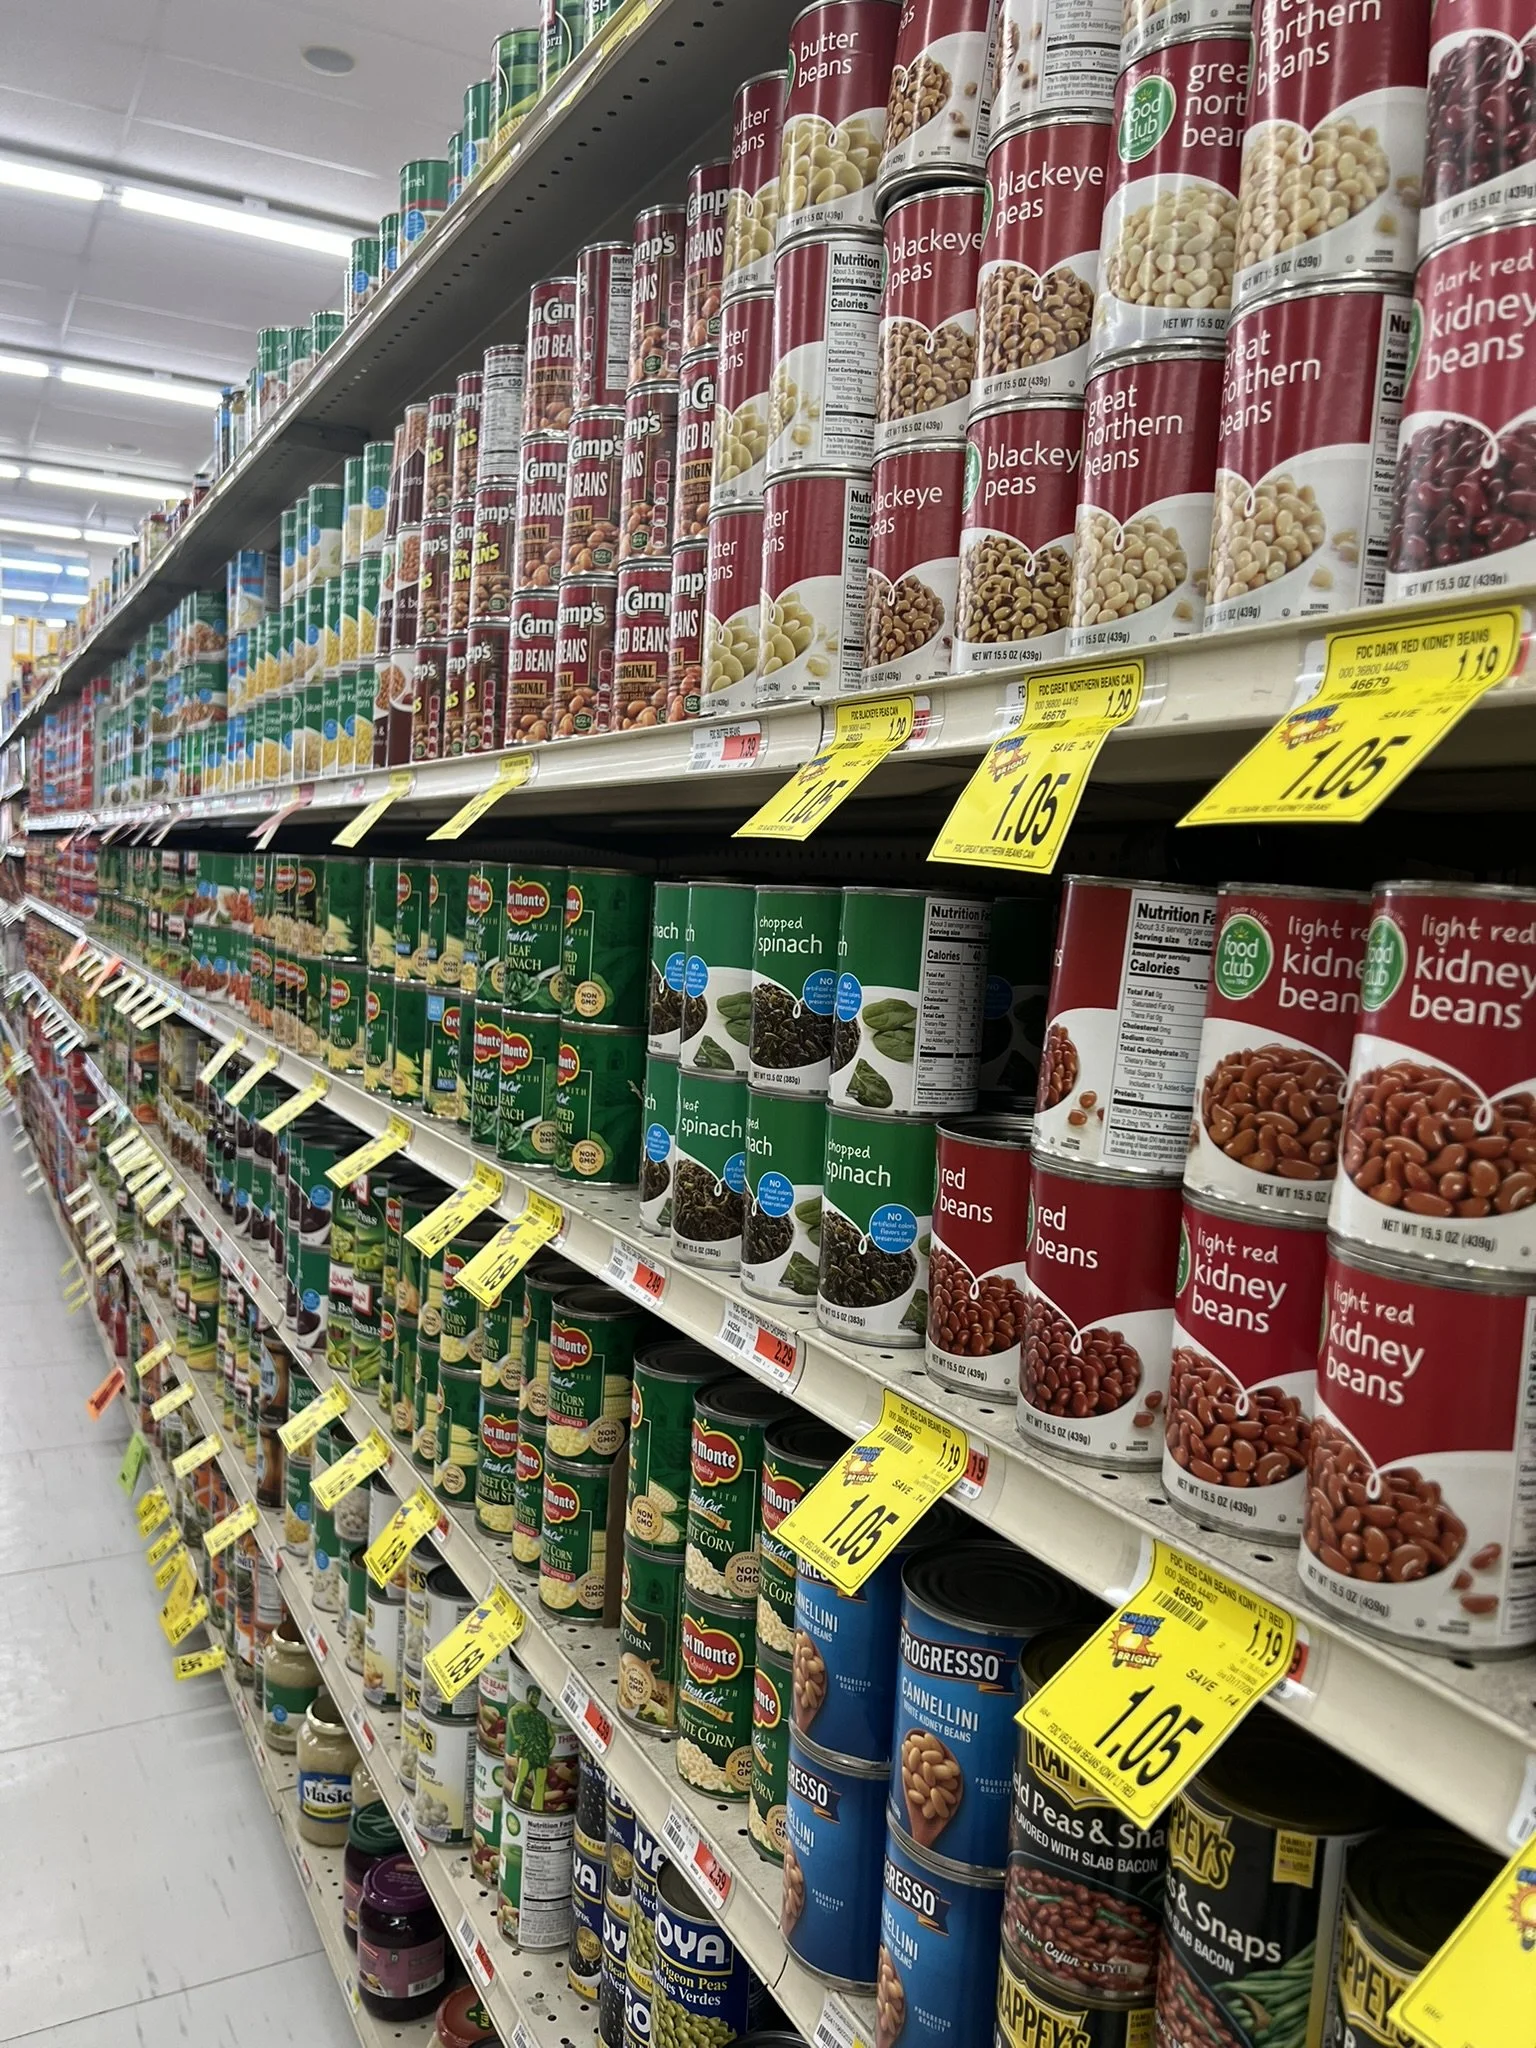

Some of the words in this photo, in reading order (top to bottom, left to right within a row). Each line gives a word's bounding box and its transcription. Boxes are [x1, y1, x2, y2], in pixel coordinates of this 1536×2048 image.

[800, 31, 858, 62] butter
[799, 57, 852, 88] beans
[1257, 38, 1329, 96] beans
[997, 161, 1103, 202] blackeye
[996, 198, 1043, 237] peas
[892, 228, 982, 264] blackeye
[834, 253, 880, 269] Nutrition
[1433, 268, 1481, 297] dark
[1490, 249, 1533, 275] red
[891, 260, 932, 297] peas
[831, 298, 869, 310] Calories
[1429, 289, 1536, 340] kidney
[1163, 318, 1178, 328] NET
[1181, 318, 1193, 328] WT
[1195, 318, 1212, 329] 15.5
[1425, 334, 1525, 382] beans
[1222, 357, 1321, 409] northern
[1088, 384, 1137, 429] great
[1085, 414, 1183, 450] northern
[1219, 400, 1272, 441] beans
[1083, 448, 1140, 480] beans
[985, 476, 1036, 505] peas
[1085, 634, 1098, 645] 15.5
[1099, 634, 1107, 643] OZ
[1107, 631, 1130, 643] (439g)
[1356, 646, 1373, 660] FDC
[1374, 642, 1400, 658] DARK
[1401, 640, 1419, 655] RED
[1421, 634, 1454, 652] KIDNEY
[1457, 628, 1490, 647] BEANS
[982, 651, 992, 661] WT
[994, 650, 1008, 660] 15.5
[1008, 650, 1017, 660] OZ
[1019, 650, 1042, 661] (439g)
[1039, 685, 1051, 696] FDC
[1052, 682, 1068, 695] GREAT
[1070, 679, 1099, 693] NORTHERN
[1100, 676, 1120, 689] BEANS
[1121, 674, 1134, 687] CAN
[1350, 677, 1390, 691] 46679
[739, 737, 757, 758] 1.39
[1050, 741, 1077, 753] SAVE
[1279, 735, 1413, 801] 1.05
[778, 779, 849, 825] 1.05
[991, 773, 1072, 846] 1.05
[759, 916, 803, 932] chopped
[931, 906, 979, 921] Nutrition
[1137, 902, 1199, 924] Nutrition
[1134, 932, 1161, 945] Serving
[1163, 935, 1180, 945] size
[1188, 937, 1199, 947] 1/2
[1288, 915, 1343, 944] light
[1422, 914, 1483, 945] light
[1491, 923, 1536, 945] red
[758, 934, 822, 956] spinach
[927, 950, 960, 961] Calories
[1132, 950, 1152, 959] Amount
[1154, 952, 1164, 961] per
[1166, 953, 1190, 962] serving
[1224, 937, 1259, 958] food
[1130, 959, 1180, 976] Calories
[1222, 958, 1254, 978] club
[1415, 945, 1536, 999] kidney
[1127, 987, 1143, 996] Total
[1143, 989, 1154, 998] Fat
[1409, 984, 1522, 1028] beans
[1122, 1022, 1159, 1032] Cholesterol
[1120, 1044, 1135, 1053] Total
[1137, 1045, 1179, 1057] Carbohydrate
[683, 1098, 699, 1112] leaf
[1114, 1089, 1137, 1099] Protein
[681, 1118, 742, 1139] spinach
[828, 1140, 871, 1159] chopped
[769, 1180, 781, 1188] NO
[826, 1160, 891, 1188] spinach
[941, 1166, 965, 1190] red
[1256, 1182, 1274, 1196] NET
[1275, 1185, 1291, 1197] WT
[1292, 1187, 1313, 1200] 15.5
[1315, 1190, 1328, 1202] OZ
[887, 1212, 902, 1221] NO
[940, 1190, 993, 1223] beans
[1037, 1205, 1066, 1232] red
[1036, 1230, 1098, 1269] beans
[1198, 1227, 1236, 1260] light
[1242, 1243, 1278, 1265] red
[1195, 1253, 1287, 1309] kidney
[1191, 1284, 1269, 1333] beans
[1333, 1280, 1369, 1314] light
[1376, 1299, 1414, 1326] red
[774, 1341, 793, 1367] 2.29
[1329, 1310, 1424, 1380] kidney
[1326, 1353, 1405, 1406] beans
[561, 1392, 584, 1406] CORN
[597, 1435, 616, 1444] GMO
[598, 1428, 616, 1437] NON
[893, 1424, 912, 1441] 46899
[936, 1439, 961, 1473] 1.19
[847, 1473, 875, 1483] BRIGHT
[892, 1480, 911, 1495] SAVE
[636, 1508, 653, 1521] NON
[636, 1516, 653, 1528] GMO
[700, 1532, 735, 1553] CORN
[822, 1494, 900, 1566] 1.05
[1173, 1585, 1203, 1611] 46890
[1119, 1612, 1164, 1625] SMART
[1133, 1624, 1158, 1635] BUY
[901, 1627, 998, 1681] PROGRESSO
[1245, 1619, 1283, 1666] 1.19
[445, 1640, 485, 1683] 1.69
[1116, 1651, 1158, 1666] BRIGHT
[836, 1674, 871, 1687] PROGRESSO
[840, 1682, 866, 1693] QUALITY
[1186, 1668, 1217, 1693] SAVE
[902, 1676, 979, 1732] CANNELLINI
[698, 1727, 736, 1748] CORN
[1093, 1684, 1205, 1787] 1.05
[1014, 1804, 1048, 1848] FLAVORED
[1051, 1840, 1079, 1862] WITH
[1082, 1852, 1114, 1871] SLAB
[1118, 1858, 1158, 1872] BACON
[1196, 1901, 1281, 1963] Snaps
[1195, 1942, 1235, 1976] BACON
[661, 1961, 694, 1989] Pigeon
[698, 1977, 727, 1990] Peas
[679, 1987, 721, 2006] Verdes
